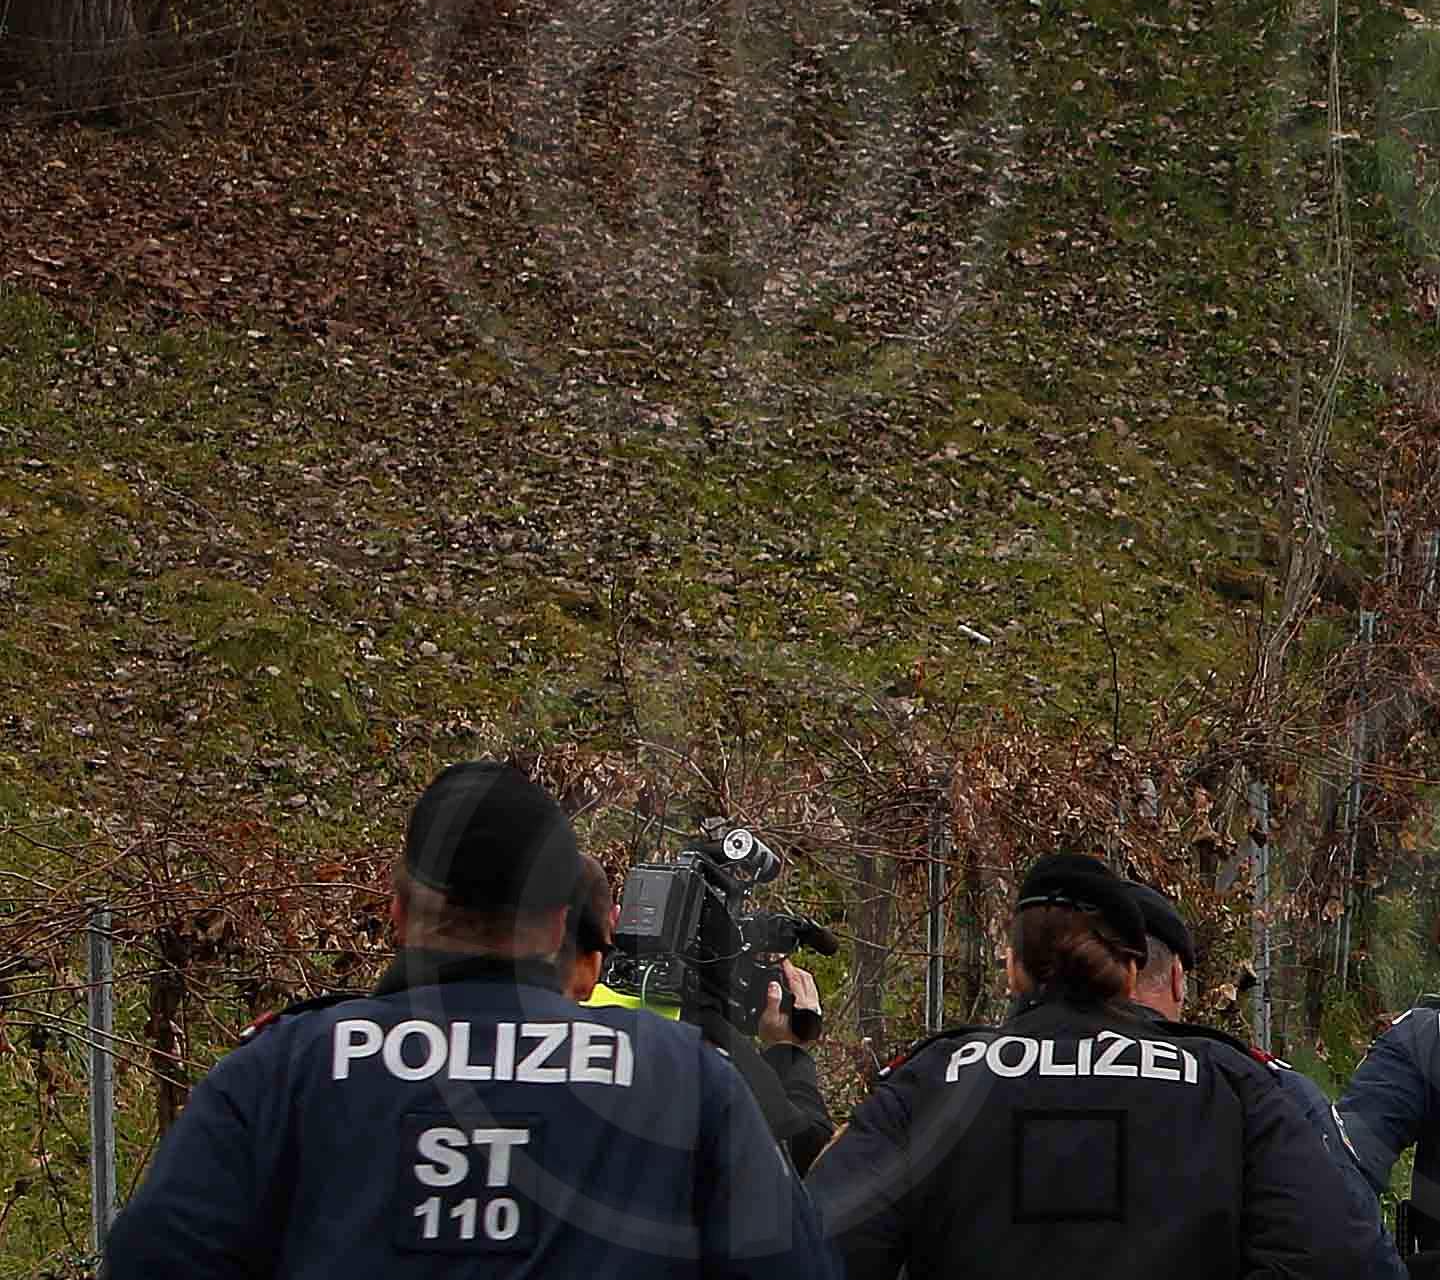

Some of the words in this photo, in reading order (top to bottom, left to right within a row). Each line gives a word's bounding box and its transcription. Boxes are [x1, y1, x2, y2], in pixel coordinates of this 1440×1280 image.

[331, 1018, 635, 1088] POLIZEI
[944, 1030, 1199, 1084] POLIZEI
[413, 1126, 530, 1189] ST
[413, 1196, 520, 1242] 110
